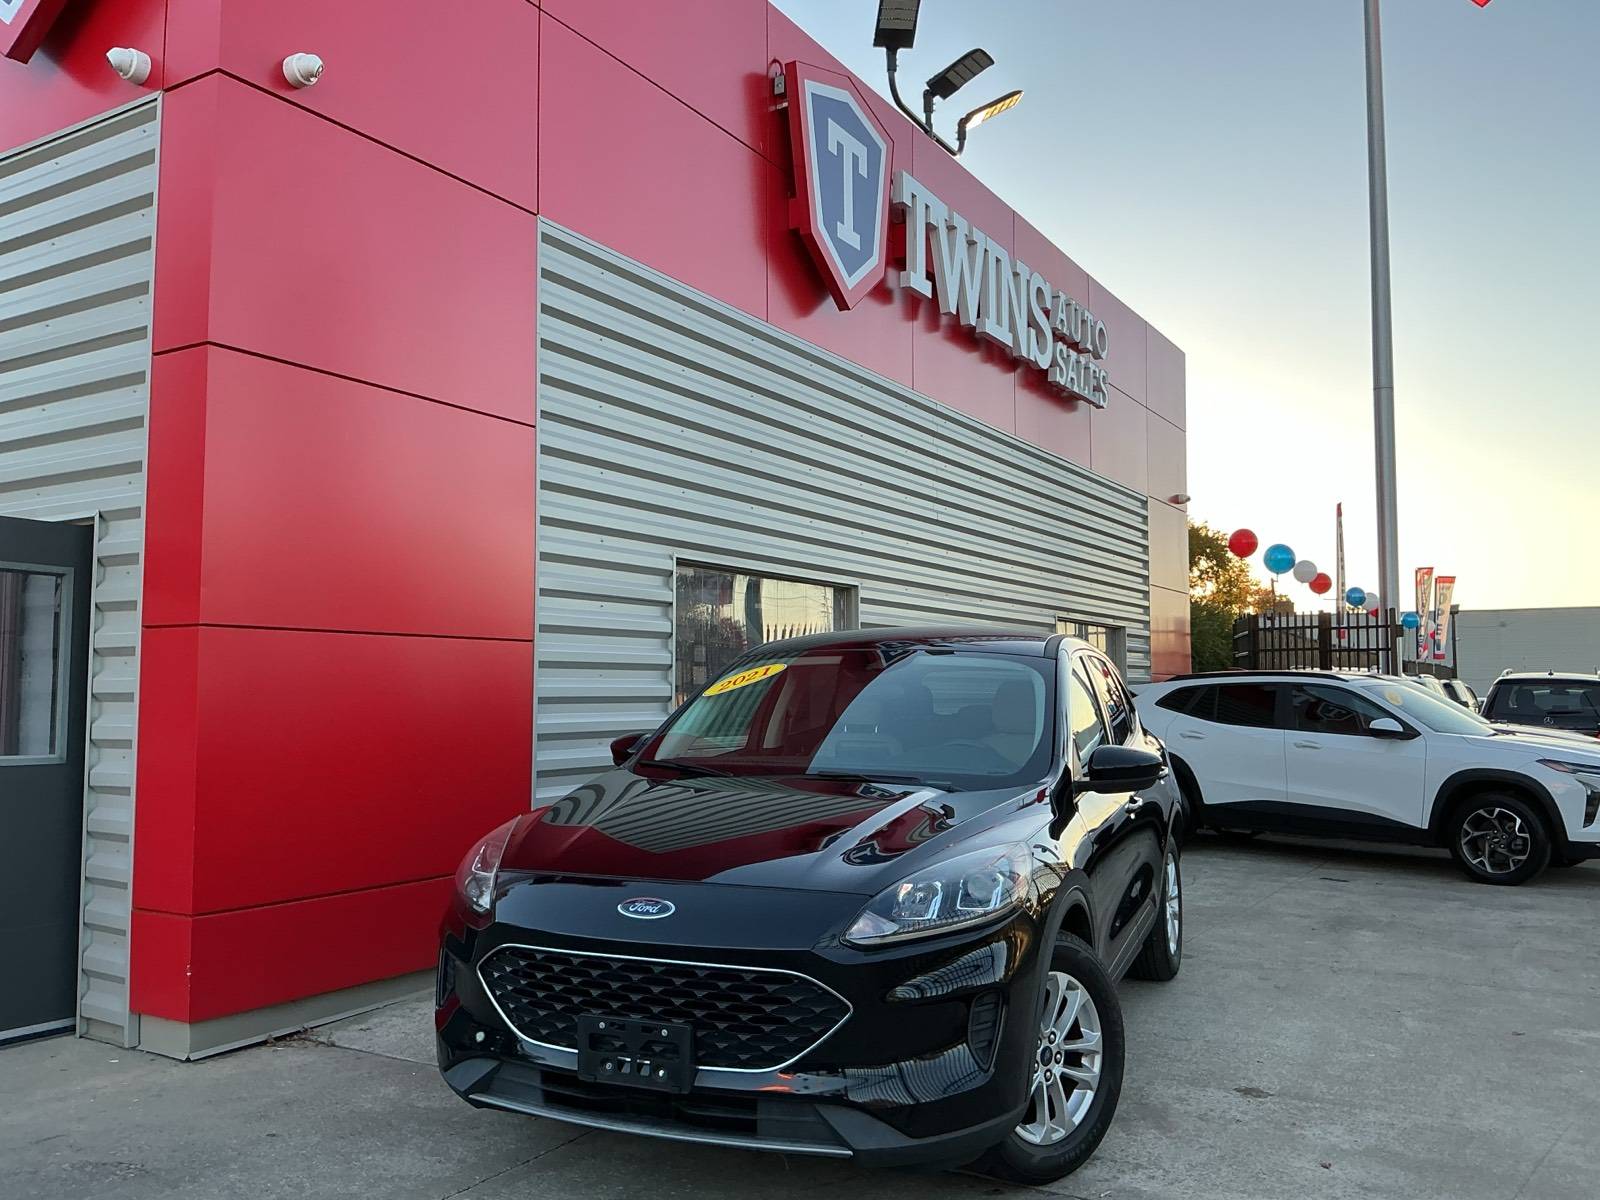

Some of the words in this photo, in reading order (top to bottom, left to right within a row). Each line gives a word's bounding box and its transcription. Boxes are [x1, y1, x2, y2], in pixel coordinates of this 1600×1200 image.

[827, 117, 868, 251] T
[894, 170, 1054, 370] TWINS
[1052, 290, 1108, 361] AUTO
[1051, 341, 1109, 409] SALES
[718, 667, 771, 692] 2021
[628, 901, 662, 913] Ford
